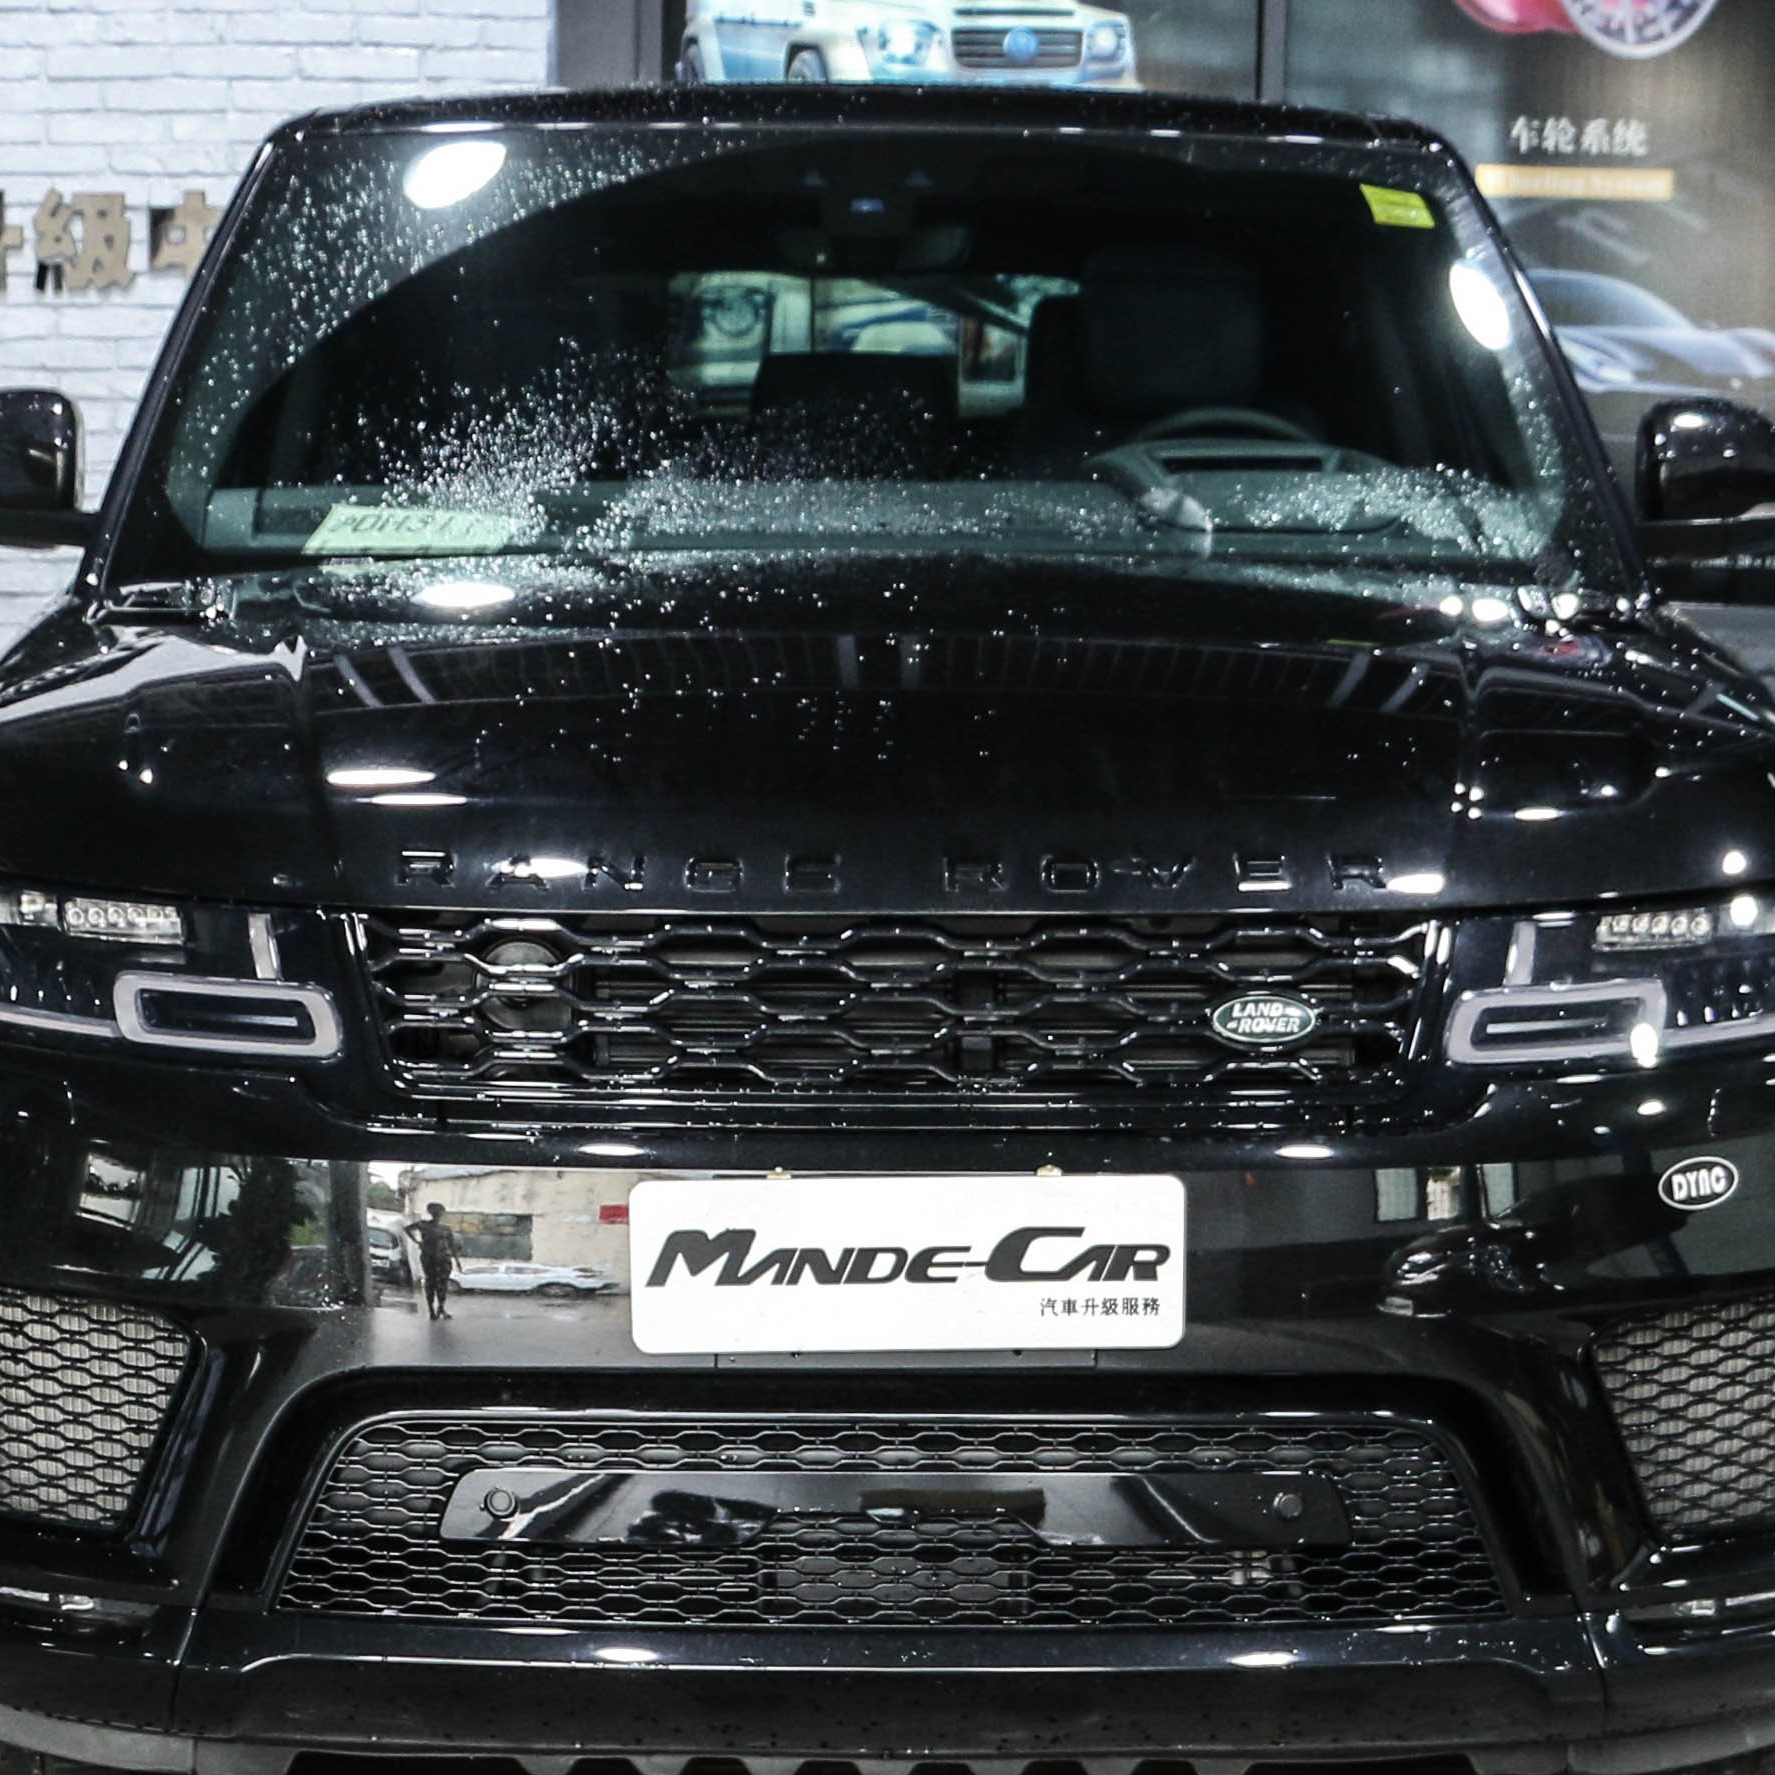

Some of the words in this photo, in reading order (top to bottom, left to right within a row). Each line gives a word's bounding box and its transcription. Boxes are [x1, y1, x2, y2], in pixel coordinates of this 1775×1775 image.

[1510, 115, 1649, 157] 车轮系统
[395, 849, 842, 893] RANGE
[943, 851, 1389, 893] ROVER
[1232, 1002, 1283, 1018] LAND
[1237, 1017, 1301, 1034] ROVER
[646, 1226, 1172, 1288] MANDE-CAR
[1038, 1296, 1162, 1317] 汽車升級服務
